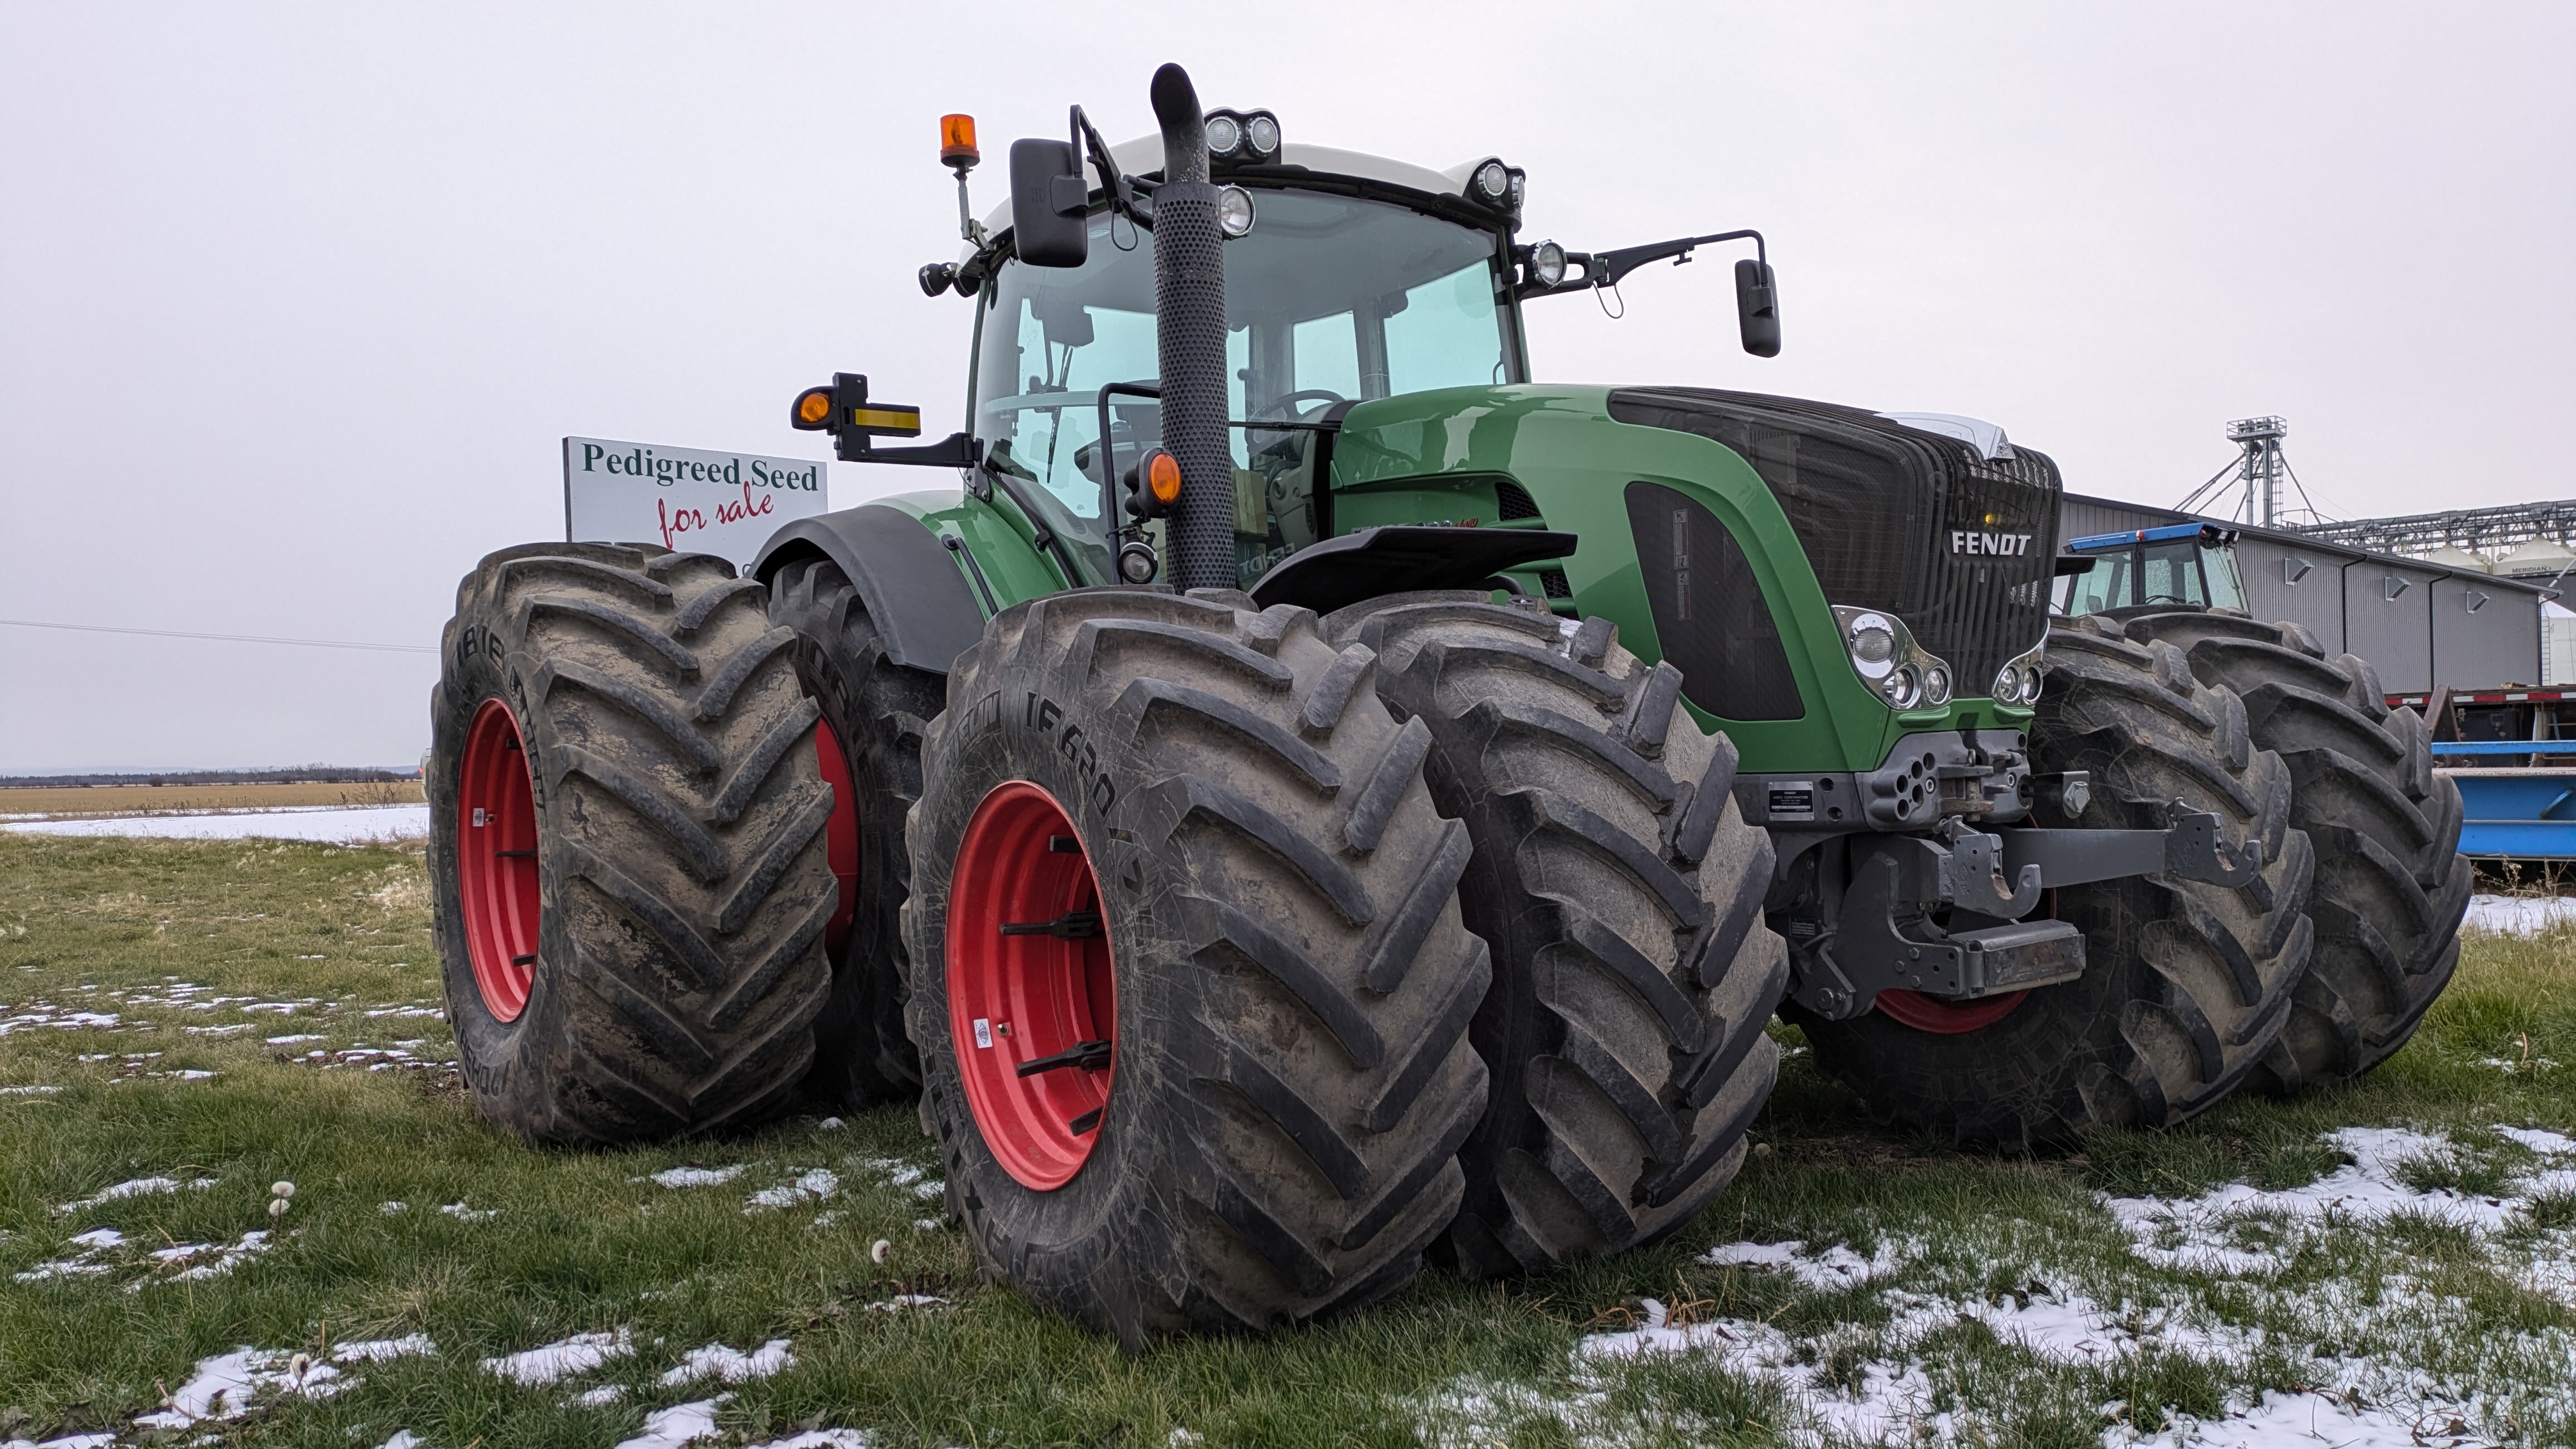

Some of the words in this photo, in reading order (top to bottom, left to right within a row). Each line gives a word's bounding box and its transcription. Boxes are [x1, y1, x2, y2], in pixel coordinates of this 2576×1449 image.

[581, 443, 741, 486] Pedigreed
[751, 460, 818, 491] Seed
[658, 498, 707, 549] for
[716, 480, 774, 524] sale
[1951, 530, 2032, 556] FENDT
